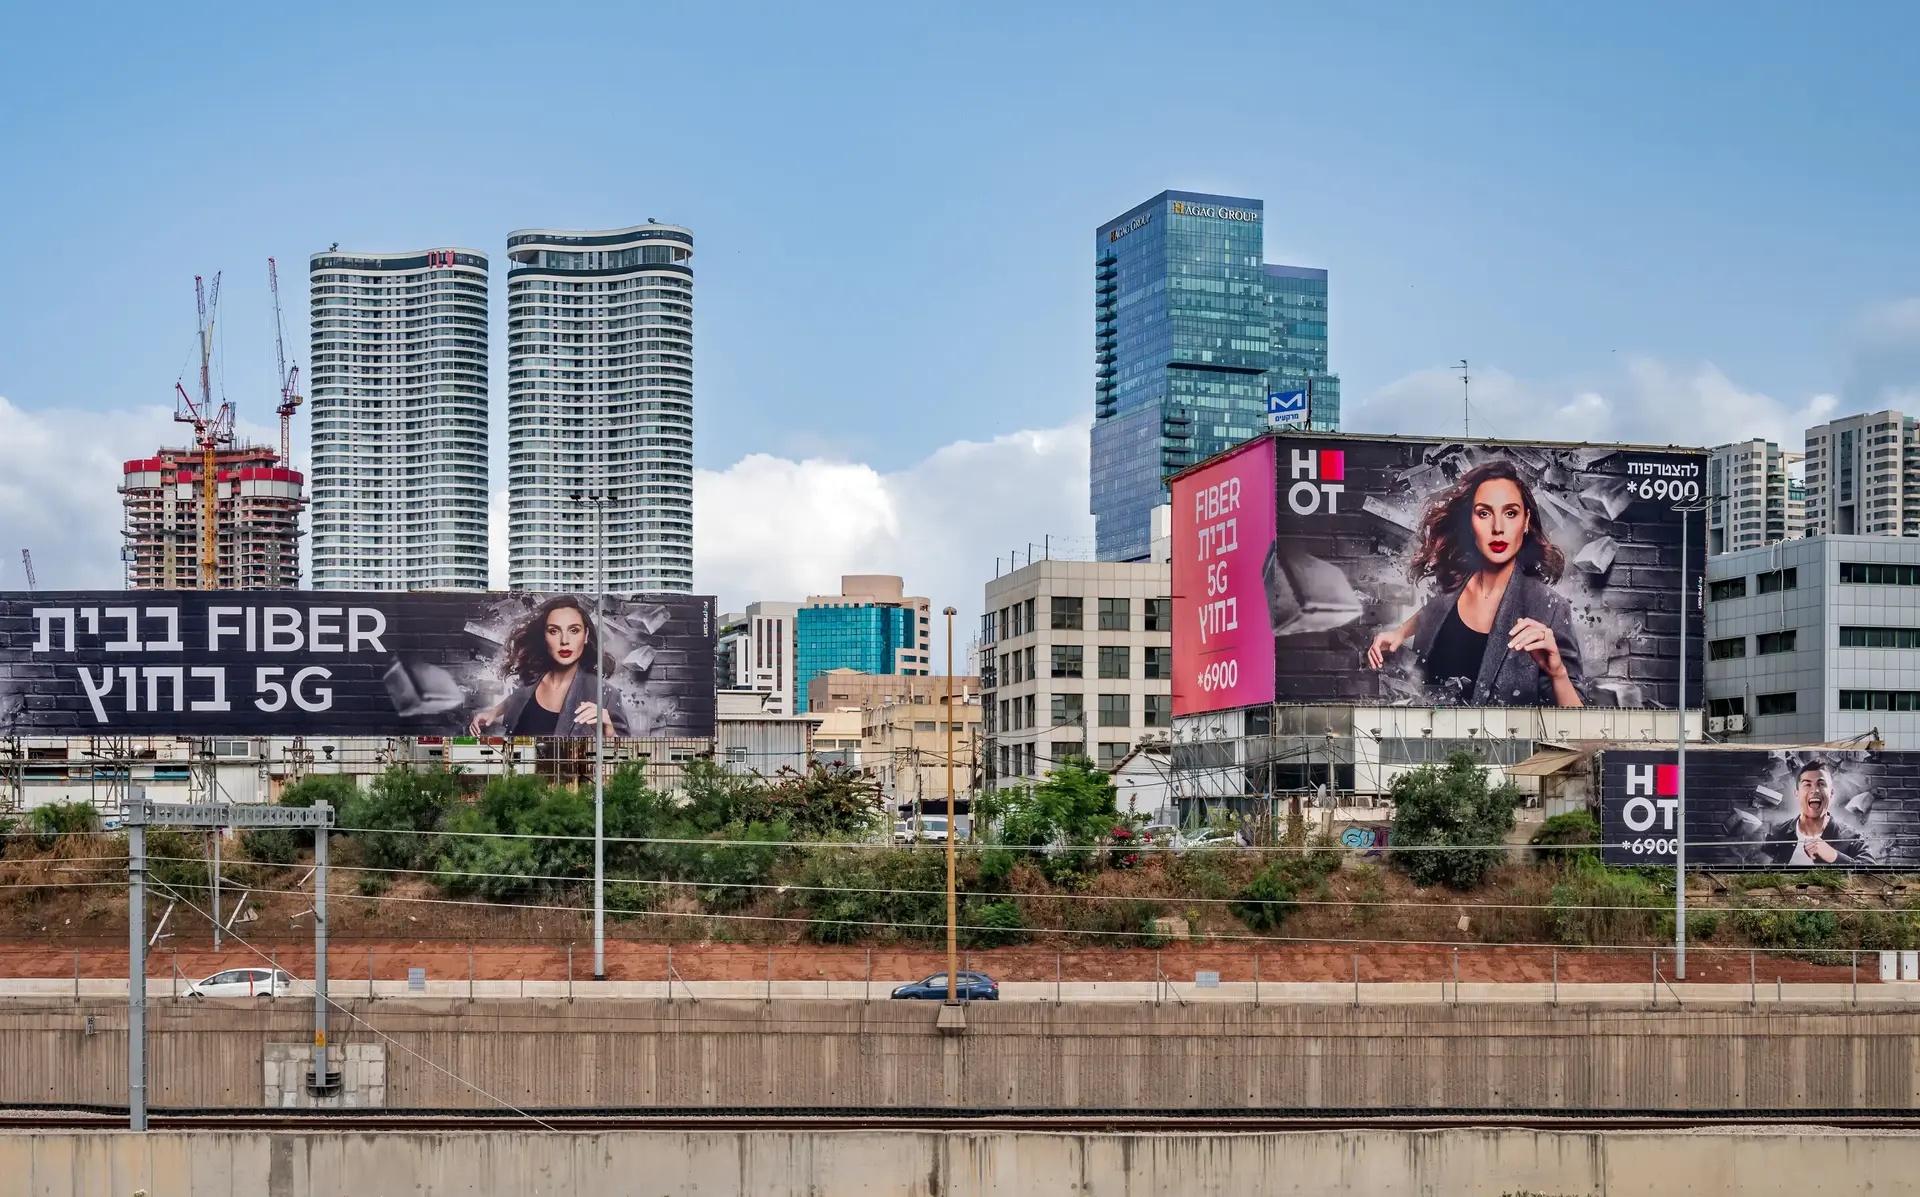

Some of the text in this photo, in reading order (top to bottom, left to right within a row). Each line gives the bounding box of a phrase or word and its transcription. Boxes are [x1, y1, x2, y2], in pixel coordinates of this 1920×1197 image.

[1131, 213, 1151, 232] GROUP
[1173, 200, 1257, 222] HAGAG GROUP
[428, 251, 454, 268] TLV
[1627, 462, 1699, 477] להצטרפות
[1195, 477, 1241, 523] FIBER
[1198, 518, 1238, 561] בבית
[1207, 561, 1227, 597] 5G
[32, 606, 387, 653] FIBER בבית
[1198, 597, 1238, 645] בחוץ
[77, 666, 333, 723] 5G בחוץ
